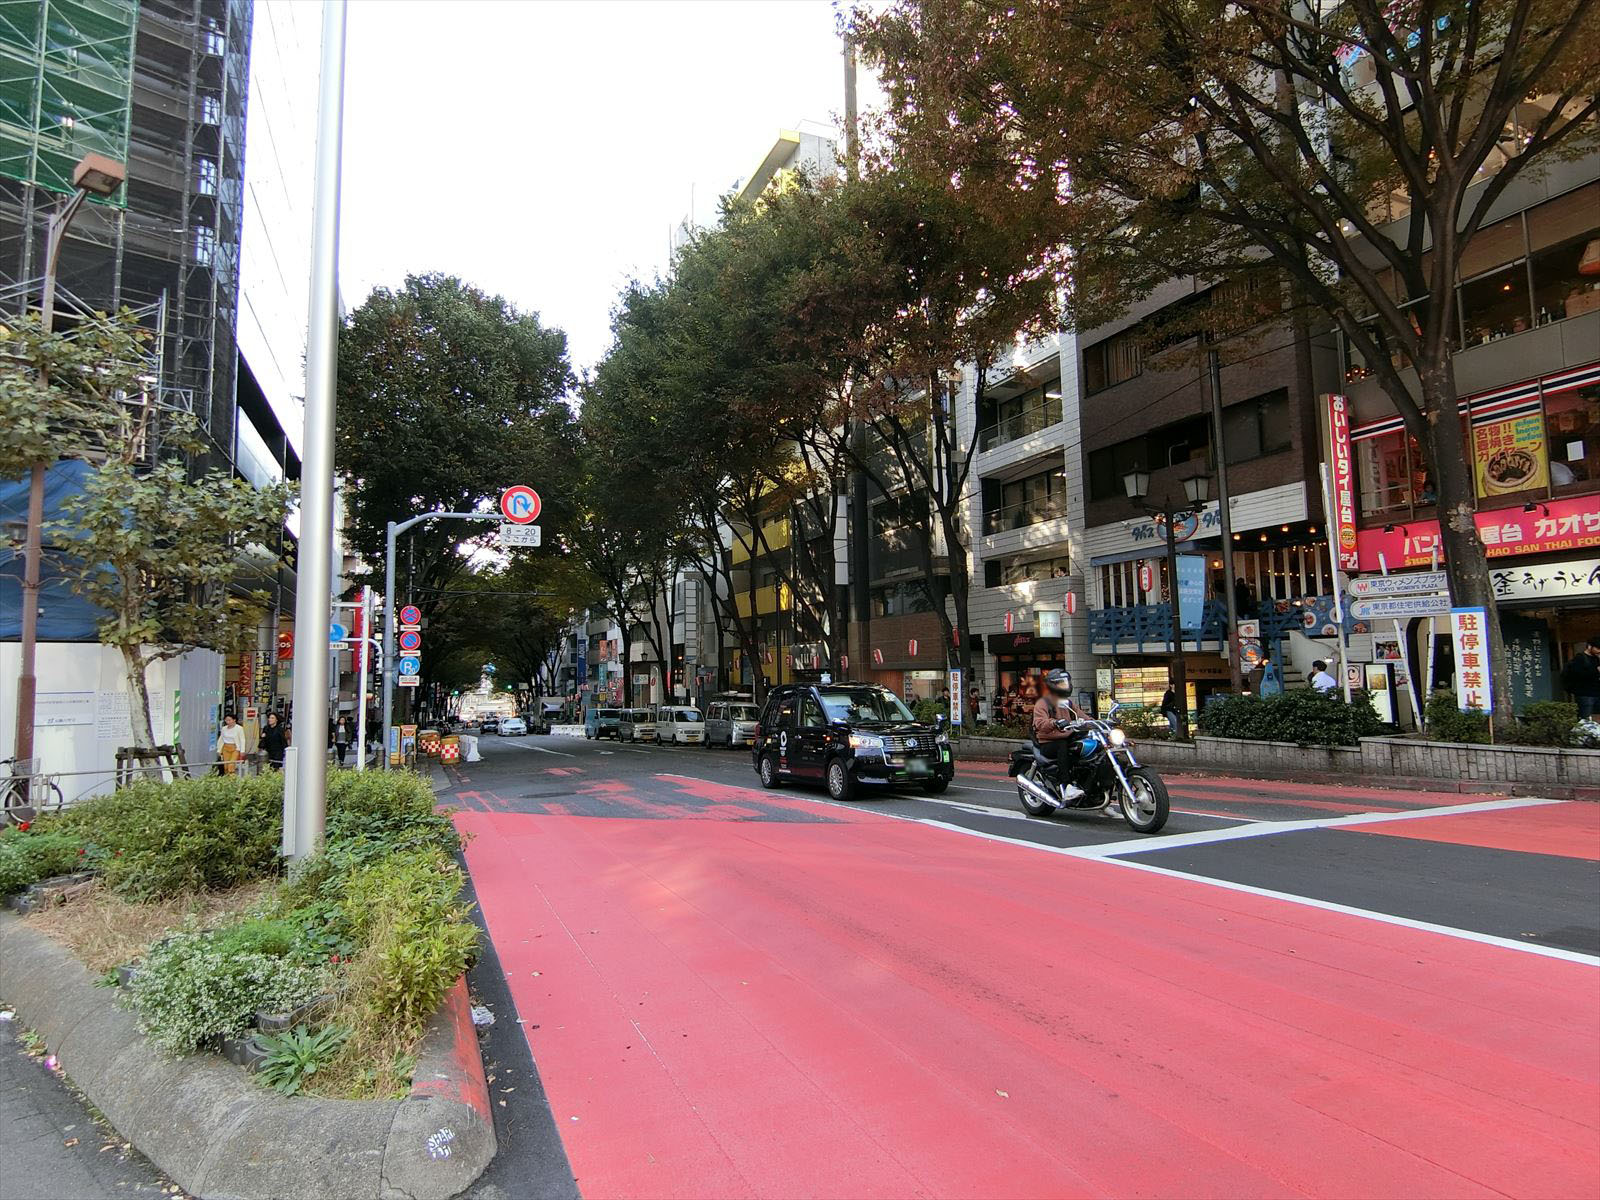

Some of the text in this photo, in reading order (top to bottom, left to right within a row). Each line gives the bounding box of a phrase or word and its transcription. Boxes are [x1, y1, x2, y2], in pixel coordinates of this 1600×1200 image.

[1333, 395, 1353, 523] おいしいタイ屋台
[504, 535, 537, 544] ここから
[1403, 534, 1444, 555] バン
[1514, 543, 1540, 554] SAN
[1544, 539, 1573, 551] THAI
[1370, 574, 1446, 588] 東京ウィメンズプラザ
[1372, 599, 1449, 611] 東京都住宅供給公社
[1457, 614, 1484, 709] 駐停車禁止
[952, 672, 960, 720] 駐停車禁止
